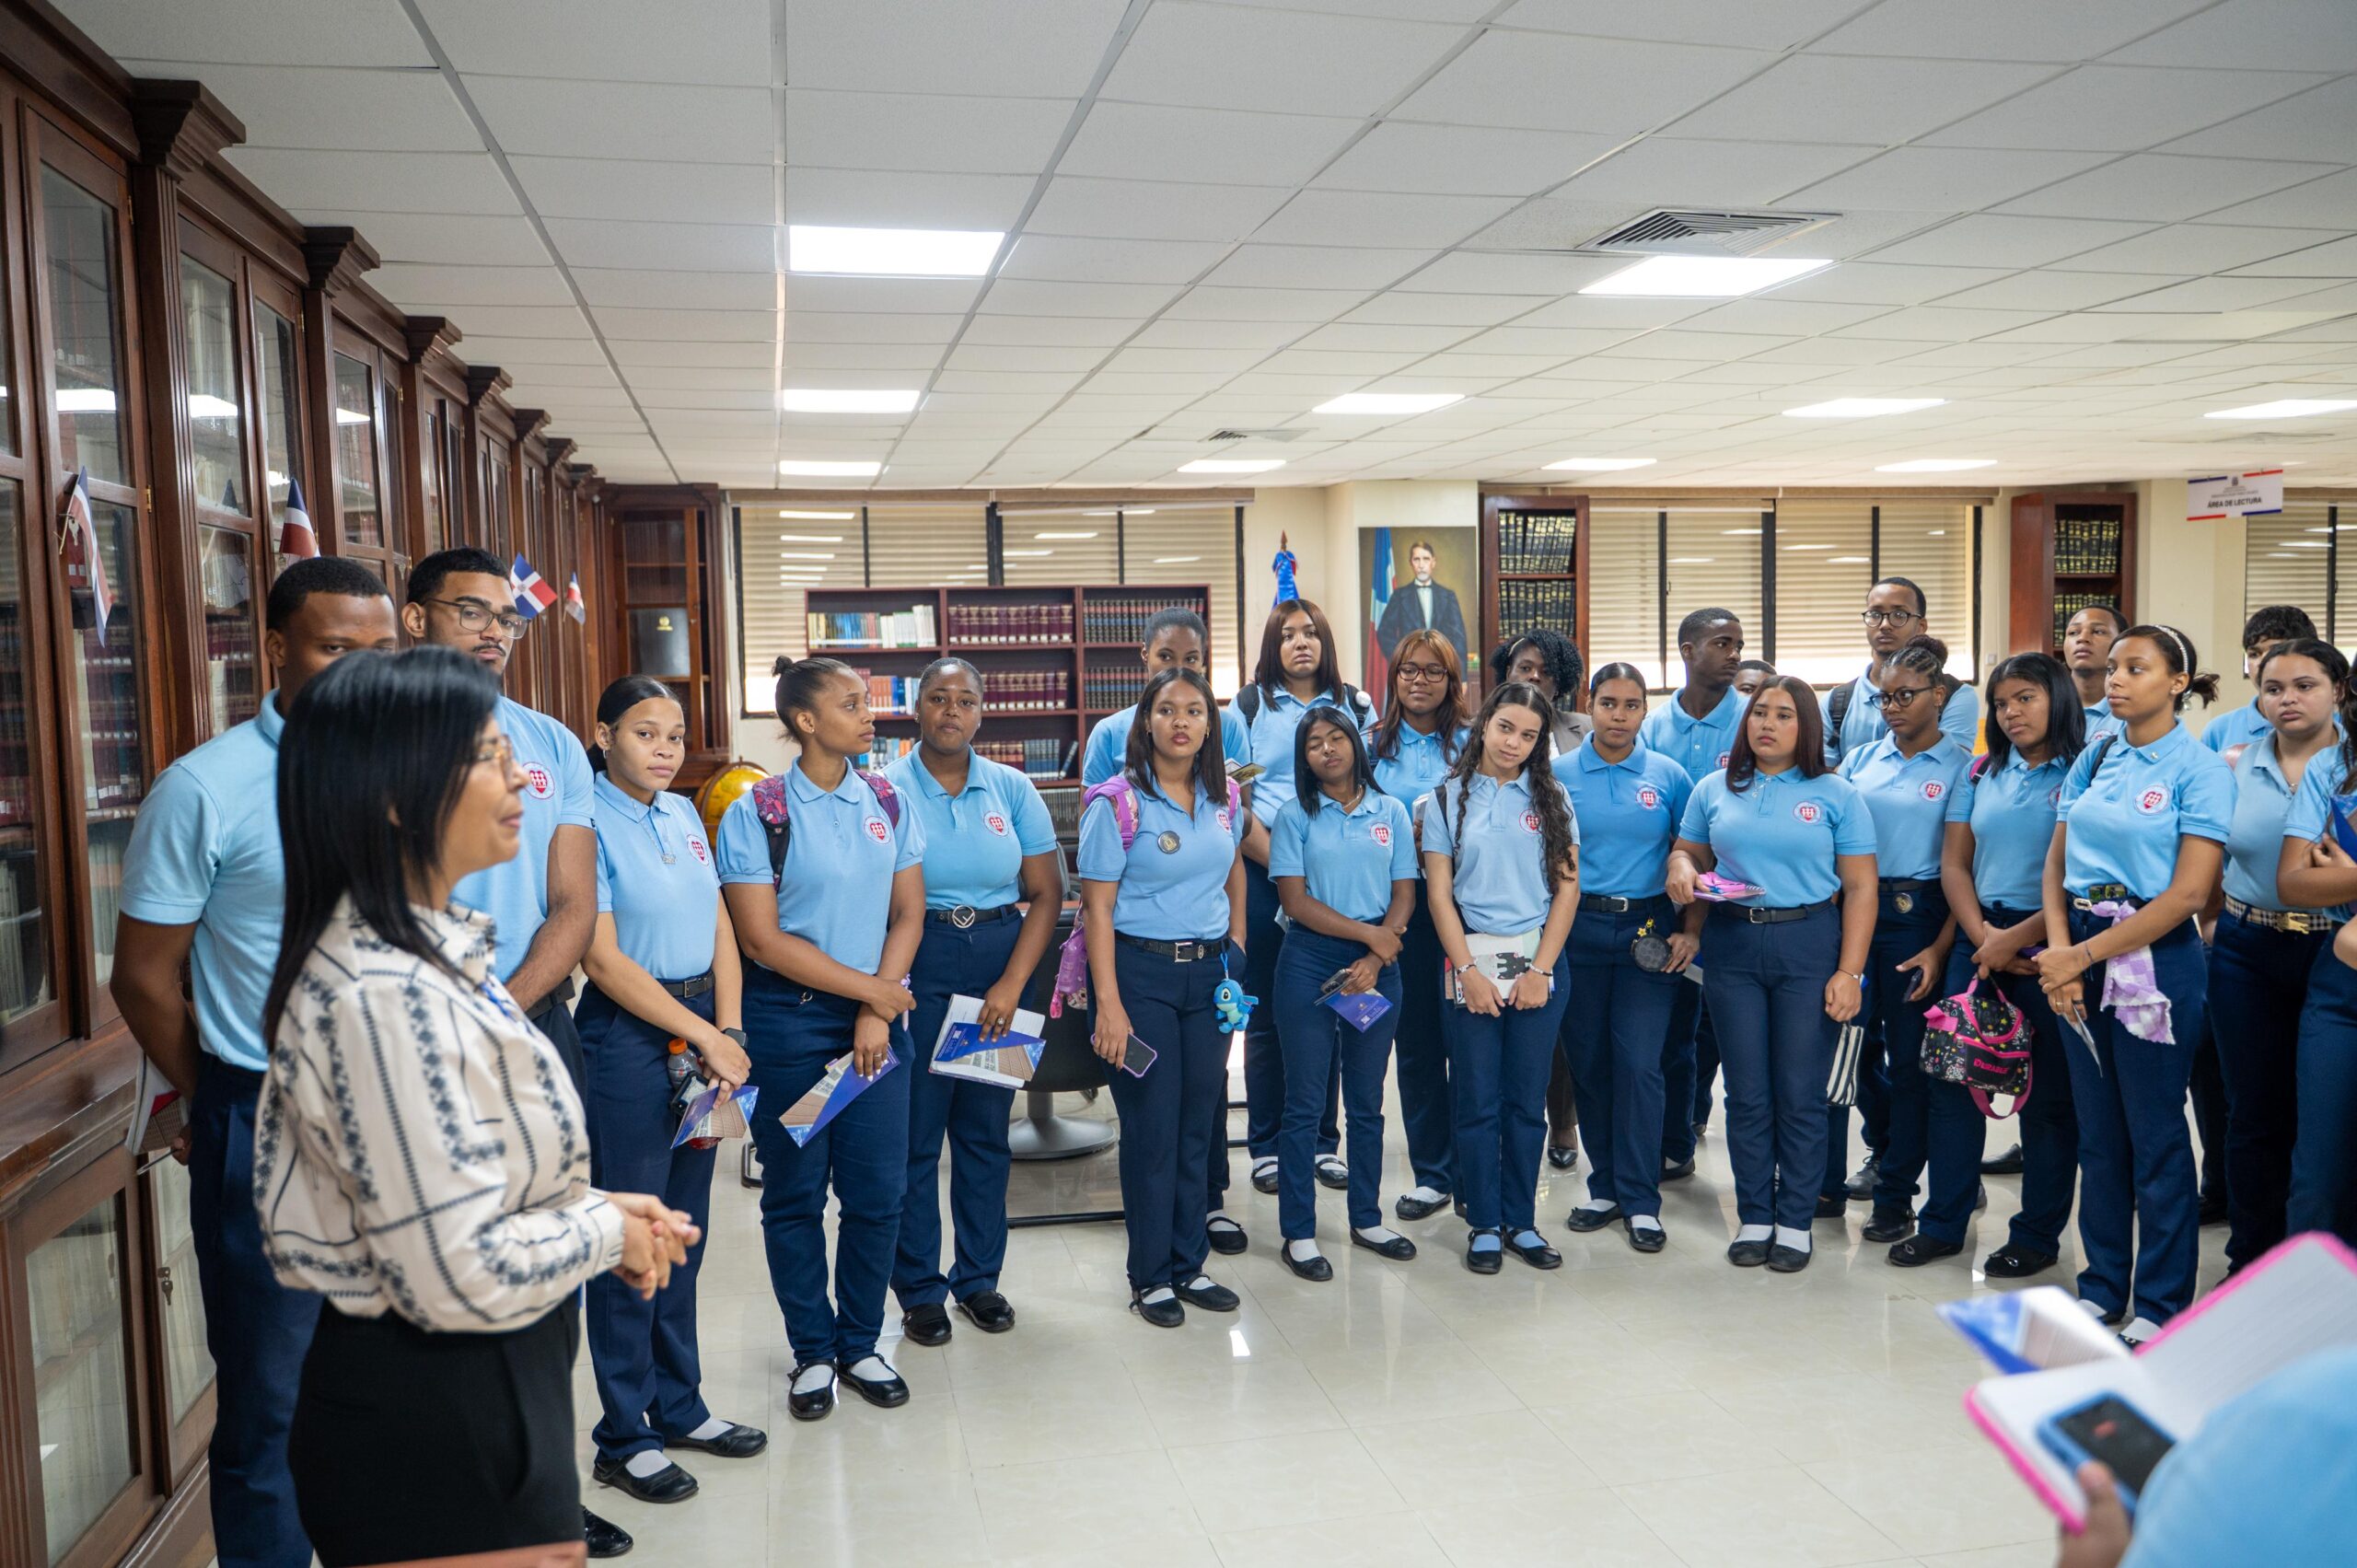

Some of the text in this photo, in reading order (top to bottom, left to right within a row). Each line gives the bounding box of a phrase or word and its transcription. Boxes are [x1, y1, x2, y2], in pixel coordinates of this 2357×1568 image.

[2207, 496, 2262, 508] ÁREA DE LECTURA
